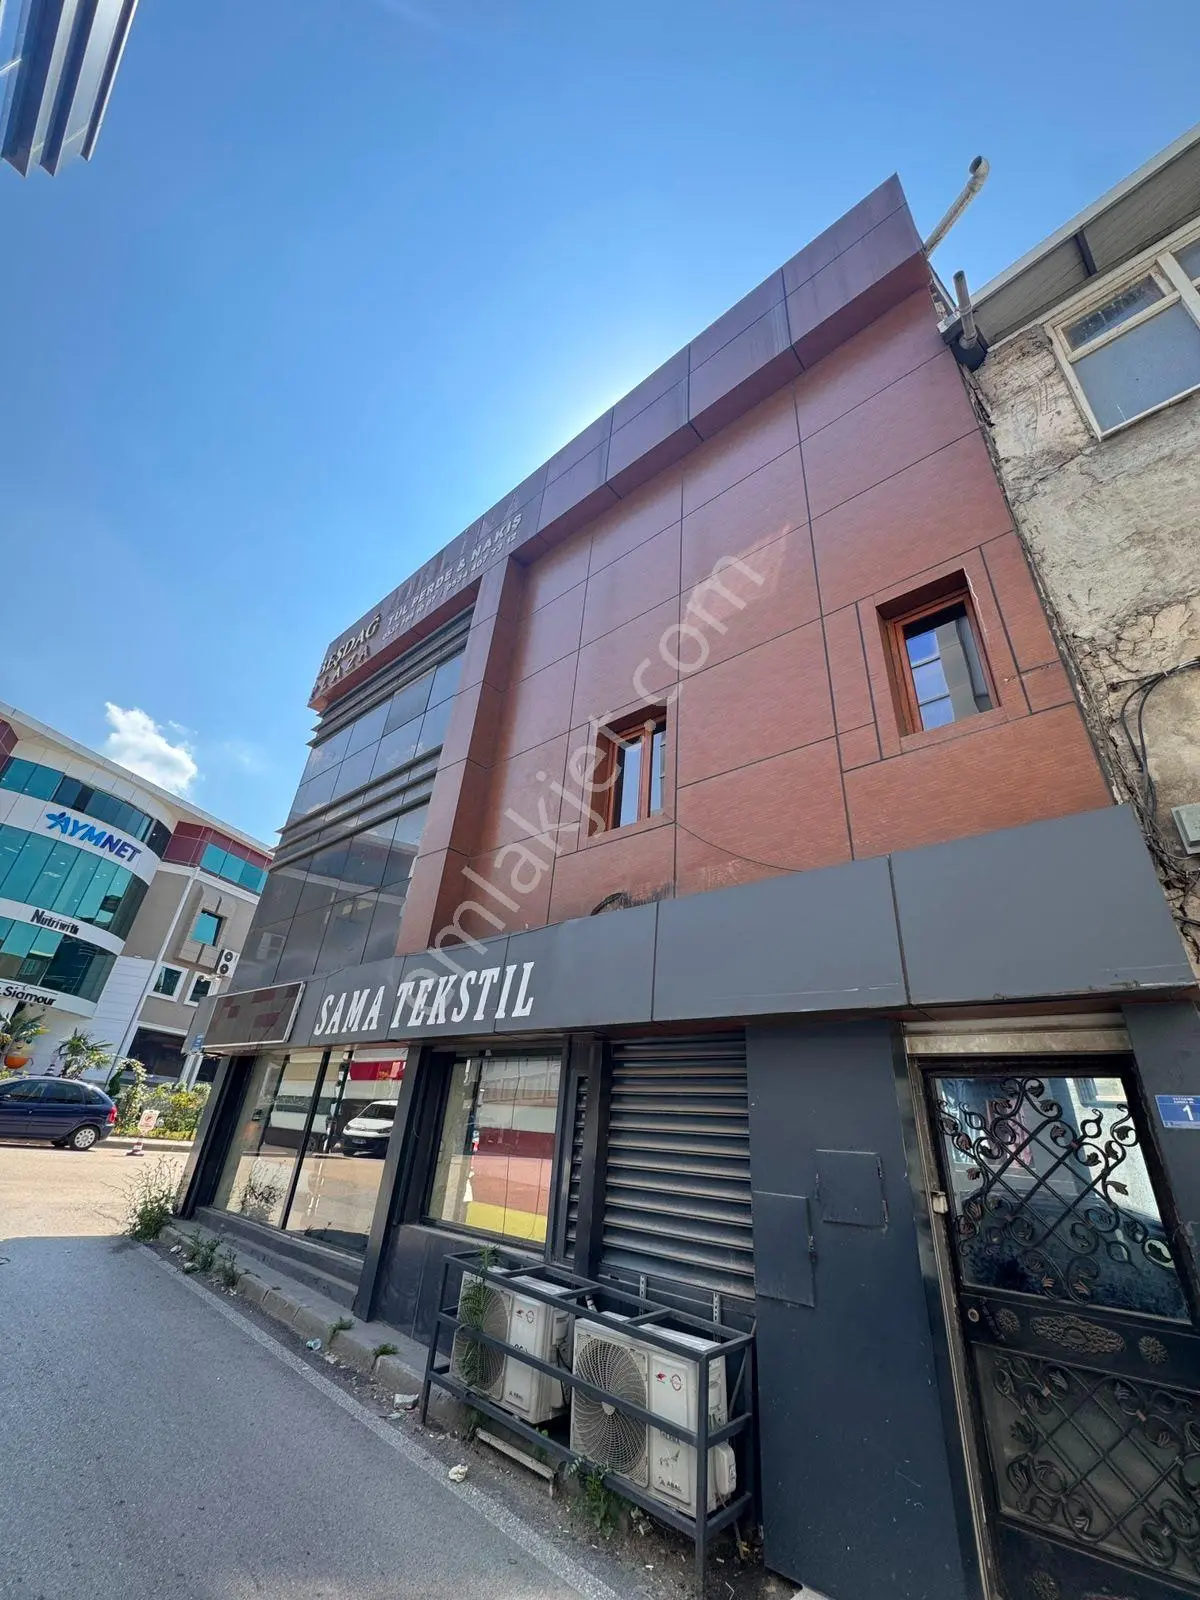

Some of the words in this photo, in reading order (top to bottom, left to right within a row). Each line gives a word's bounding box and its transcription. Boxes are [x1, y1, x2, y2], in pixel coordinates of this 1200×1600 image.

[411, 568, 454, 609] PERDE
[457, 558, 466, 572] &
[316, 644, 370, 692] LAZA
[46, 812, 142, 862] AYMNET
[313, 985, 386, 1036] SAMA
[1182, 1104, 1194, 1121] 1
